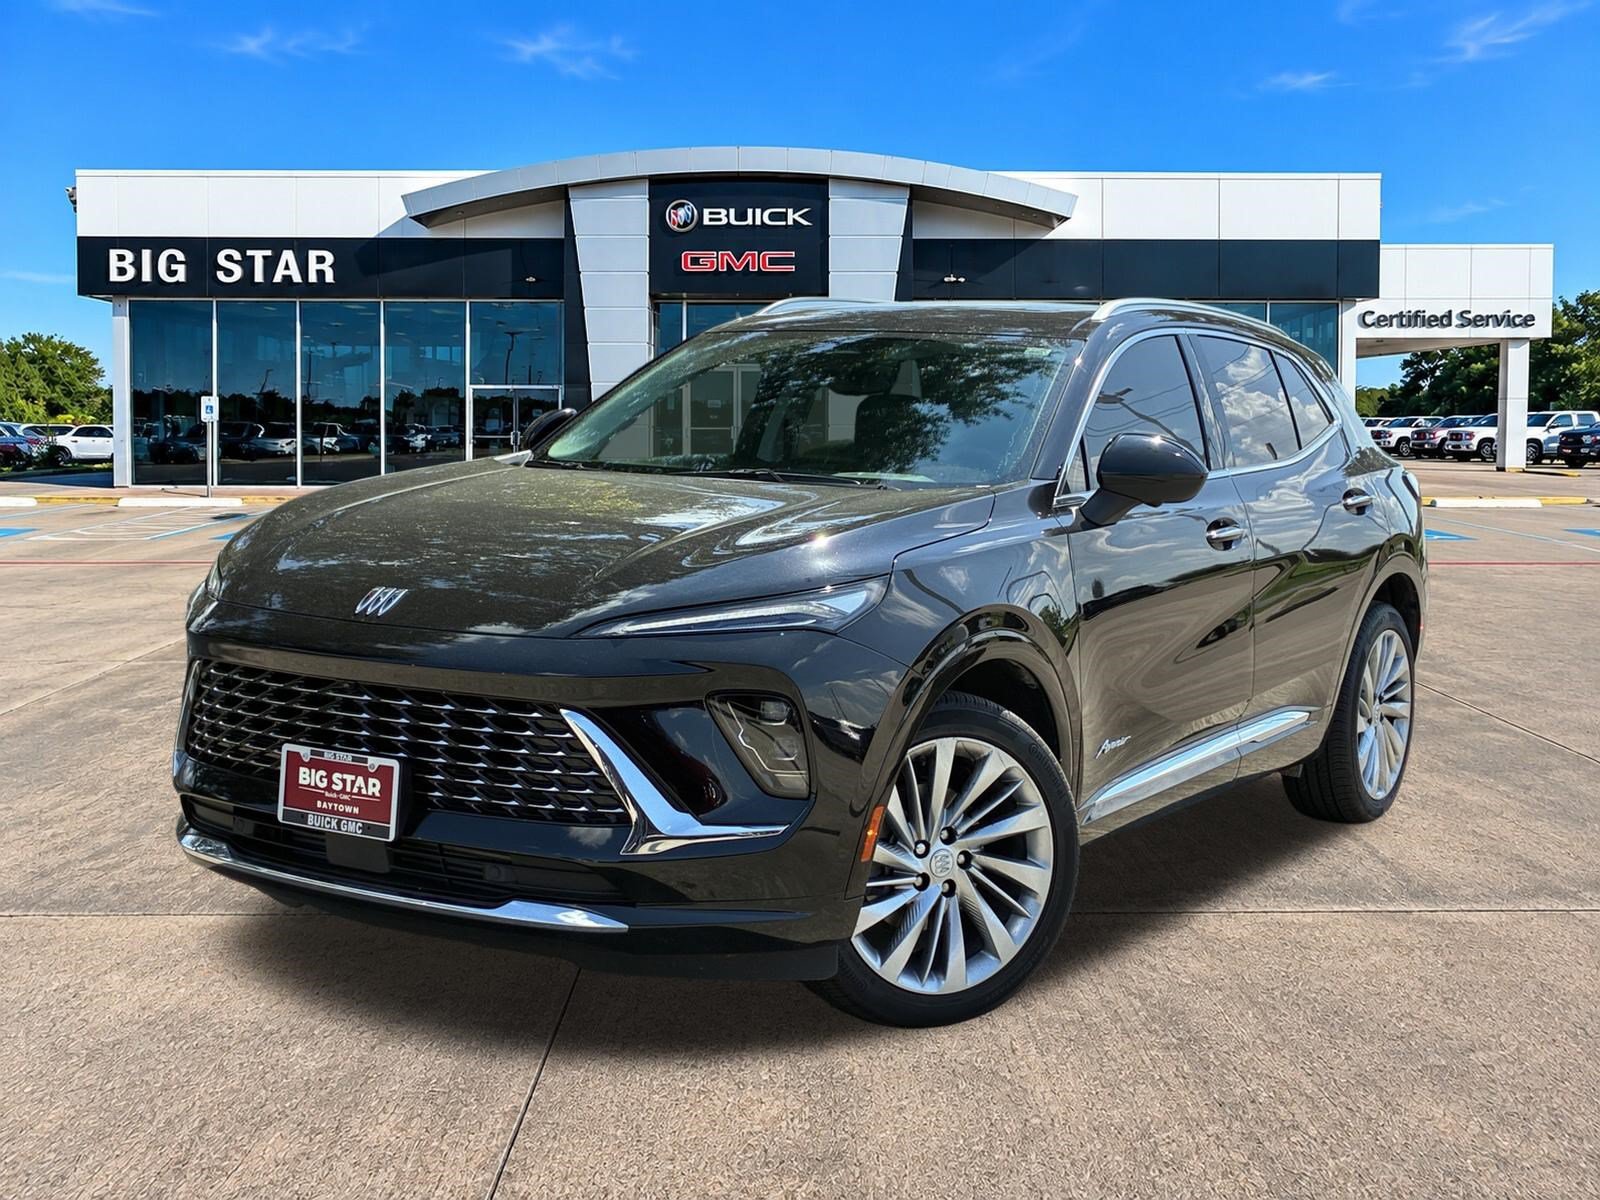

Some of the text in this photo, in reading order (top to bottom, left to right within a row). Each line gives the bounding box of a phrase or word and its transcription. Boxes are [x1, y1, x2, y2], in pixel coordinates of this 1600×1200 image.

[703, 208, 813, 226] BUICK
[108, 248, 336, 284] BIG STAR
[681, 251, 795, 272] GMC
[1361, 309, 1536, 329] Certified Service
[335, 753, 353, 762] STAR
[298, 766, 381, 797] BIG STAR
[316, 800, 360, 814] BAYTOWN
[307, 814, 363, 834] BUICK GMC
